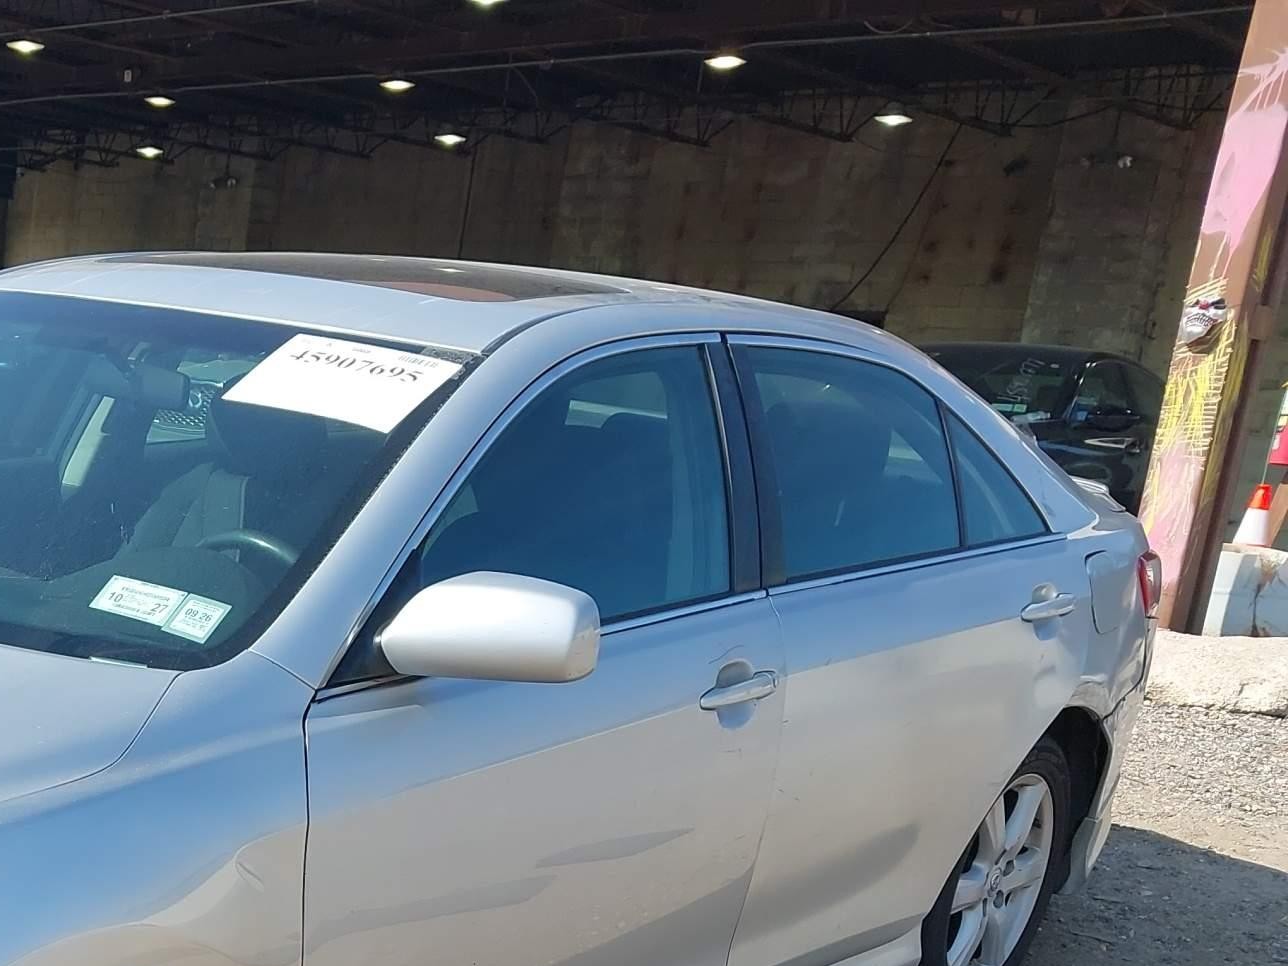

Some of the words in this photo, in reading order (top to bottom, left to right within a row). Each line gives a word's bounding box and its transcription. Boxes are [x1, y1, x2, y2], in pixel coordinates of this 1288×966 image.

[290, 350, 424, 382] 45907695
[108, 592, 123, 603] 10
[150, 603, 169, 614] 27
